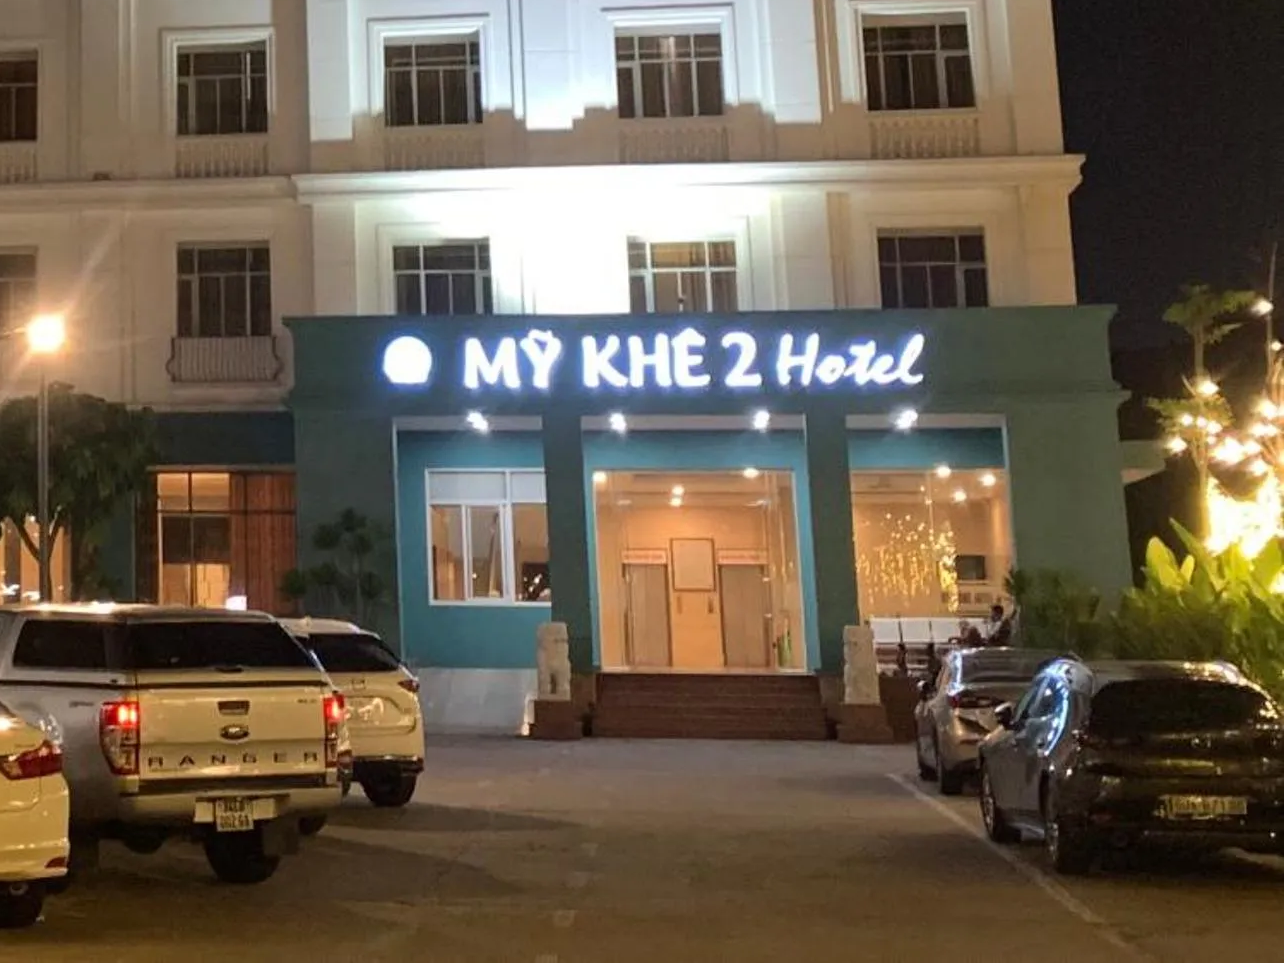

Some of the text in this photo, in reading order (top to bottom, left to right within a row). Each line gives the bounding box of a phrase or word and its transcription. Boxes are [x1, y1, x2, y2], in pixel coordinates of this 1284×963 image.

[463, 326, 925, 389] MỸ KHÊ 2 Hotel
[148, 751, 318, 768] RANGER
